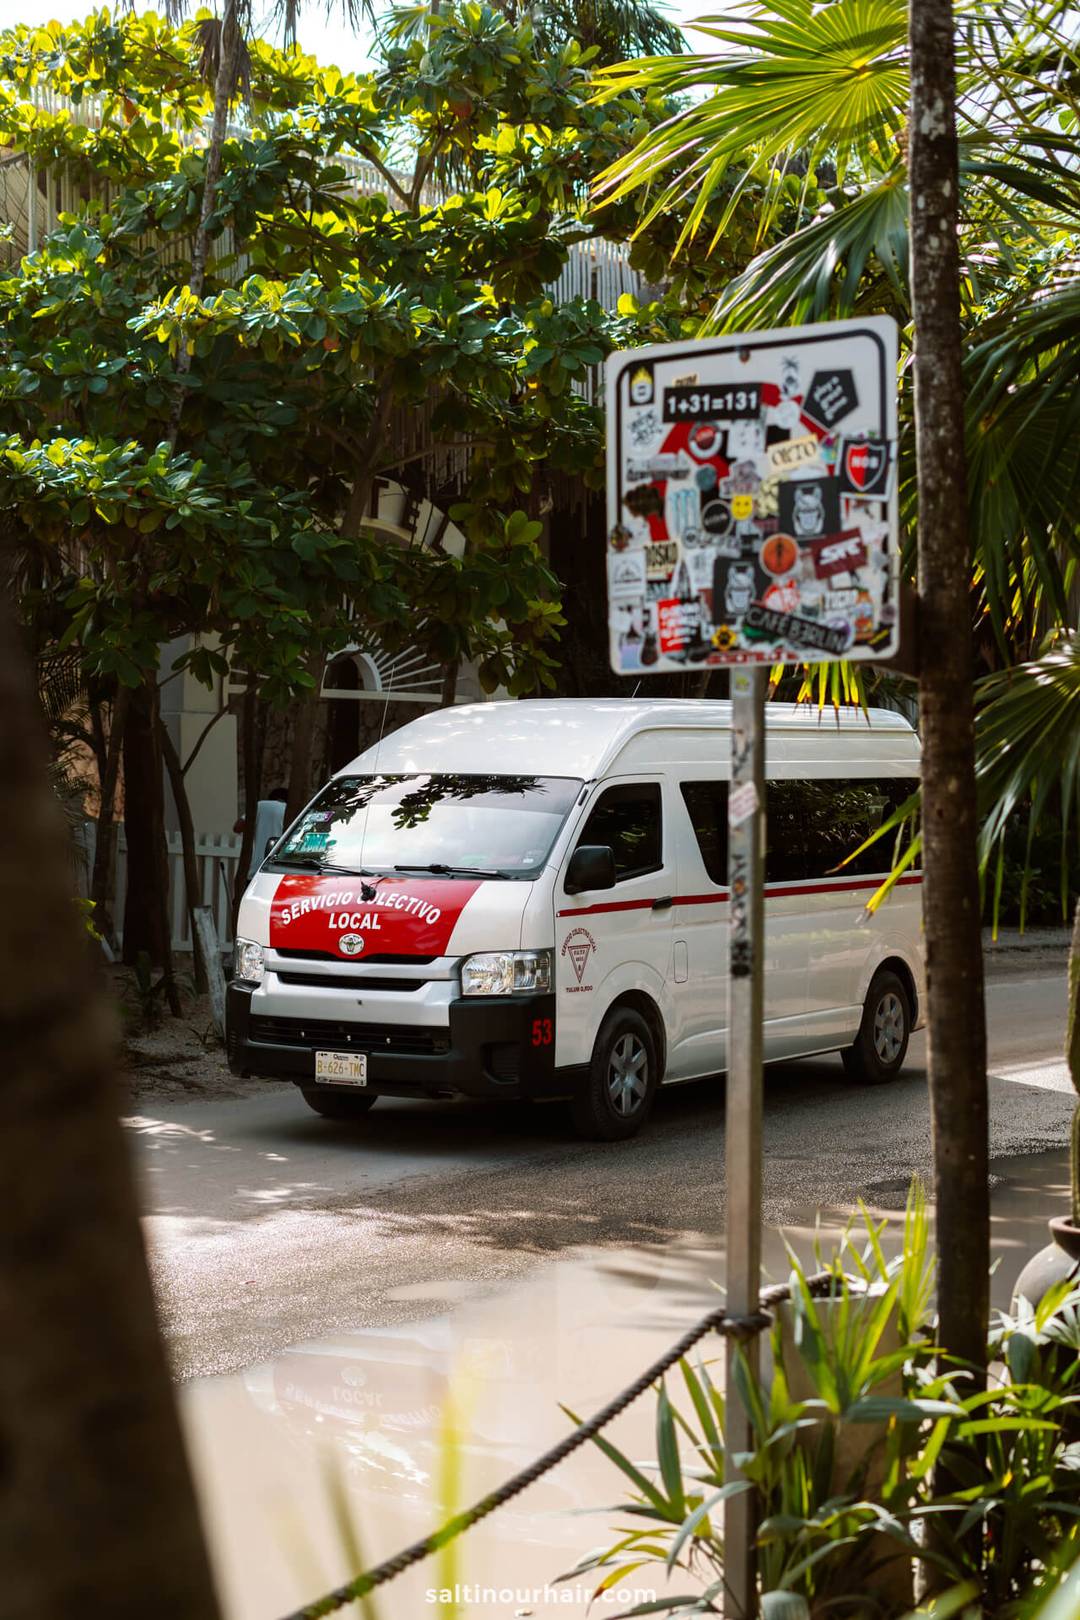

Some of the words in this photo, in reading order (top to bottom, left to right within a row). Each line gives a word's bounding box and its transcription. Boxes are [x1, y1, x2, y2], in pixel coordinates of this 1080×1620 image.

[667, 390, 758, 415] 1+31=131
[281, 891, 352, 925] SERVICIO
[328, 912, 382, 930] LOCAL
[531, 1018, 552, 1047] 53
